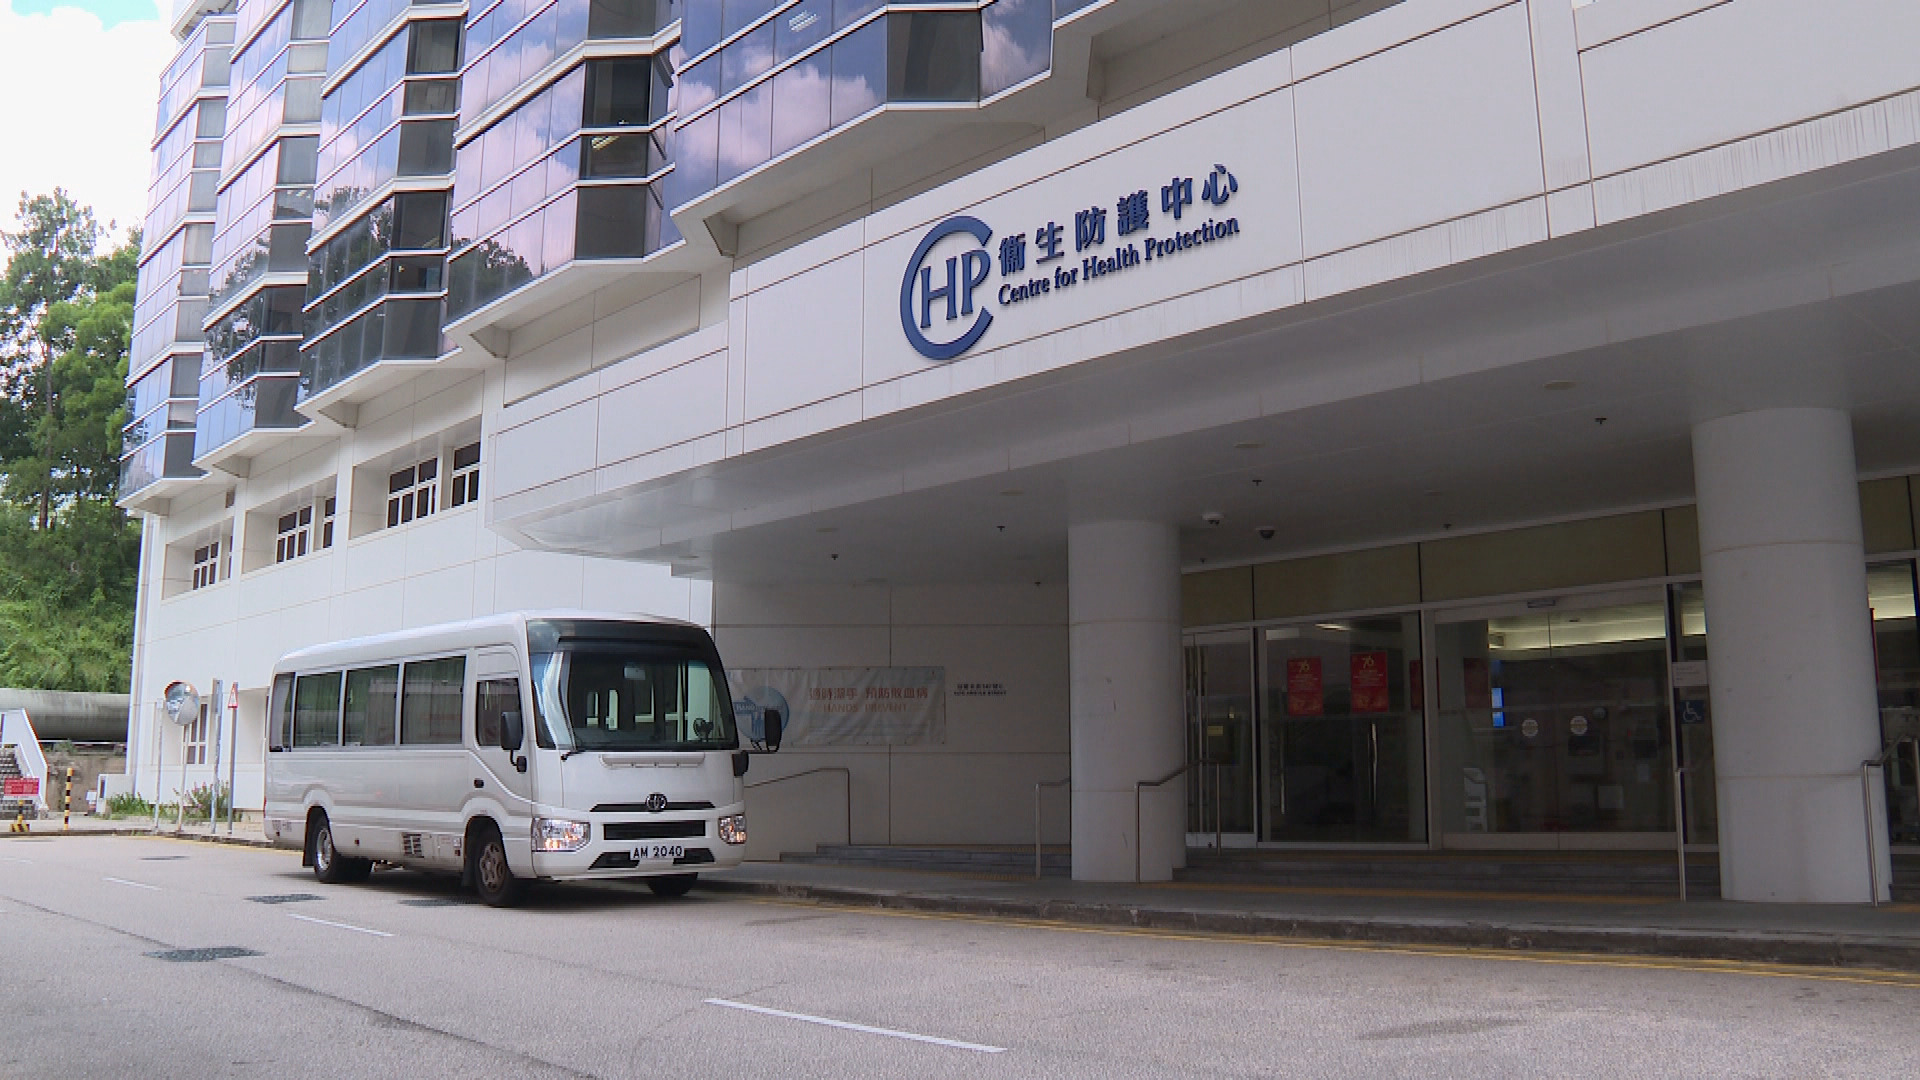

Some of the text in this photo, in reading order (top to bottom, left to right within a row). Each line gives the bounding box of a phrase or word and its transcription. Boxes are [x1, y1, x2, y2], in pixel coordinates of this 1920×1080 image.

[900, 215, 994, 360] CHP
[999, 217, 1241, 306] Centre for Health Protection
[633, 845, 683, 858] AM 2040
